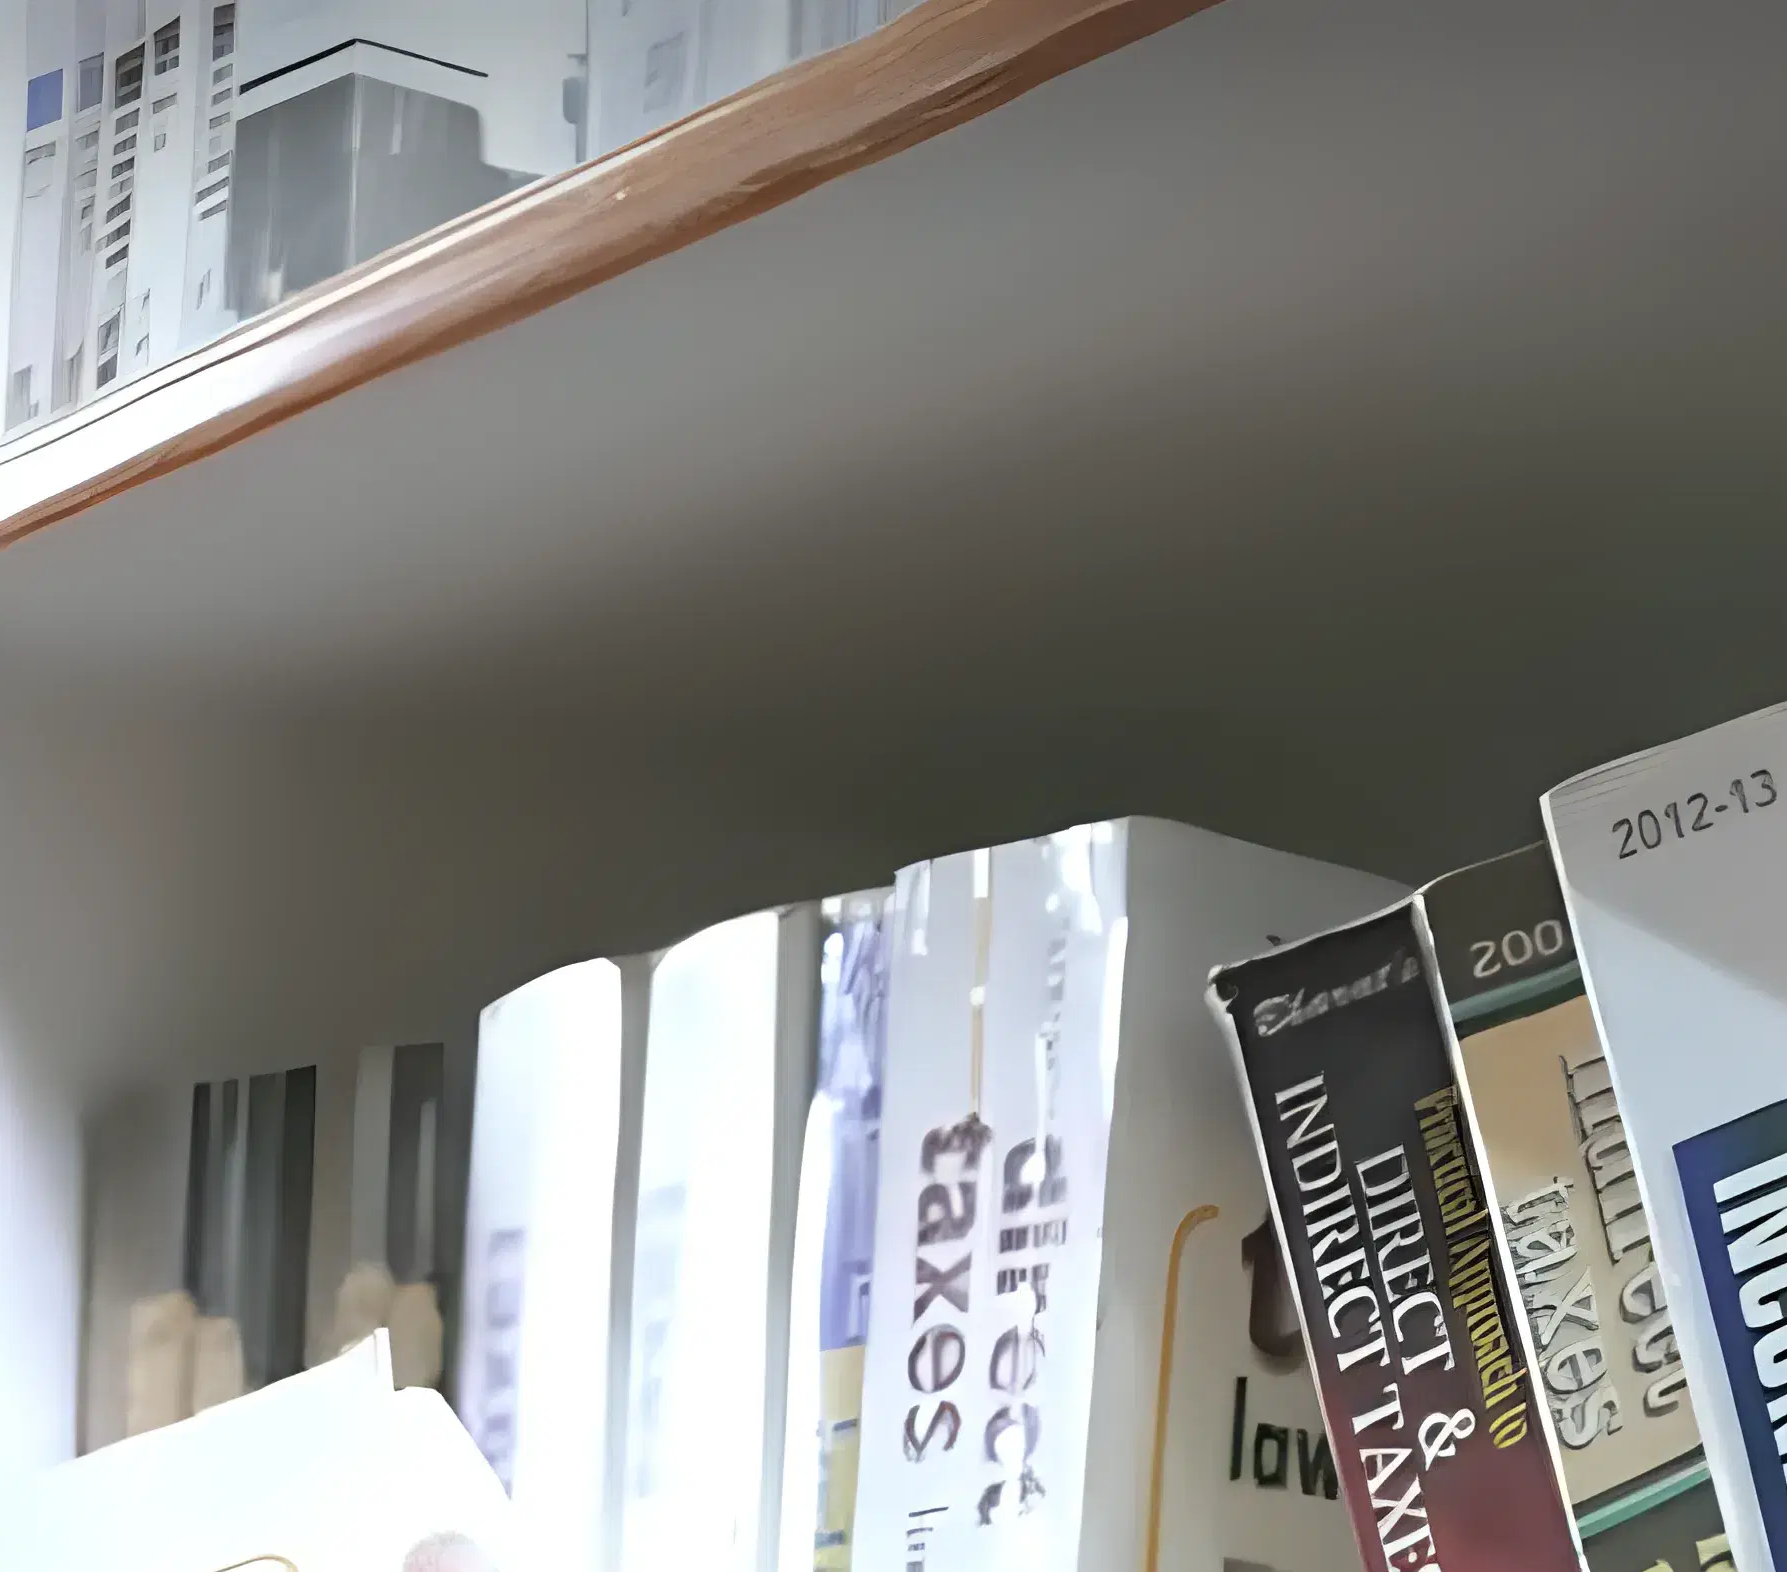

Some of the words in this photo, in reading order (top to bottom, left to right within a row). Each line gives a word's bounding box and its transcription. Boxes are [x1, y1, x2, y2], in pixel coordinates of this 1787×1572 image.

[1613, 769, 1778, 860] 2012-13
[904, 1110, 994, 1464] taxes
[1275, 1070, 1390, 1374] INDIRECT
[1355, 1144, 1458, 1376] DIRECT
[1418, 1408, 1476, 1471] &
[1500, 1176, 1624, 1451] taxes
